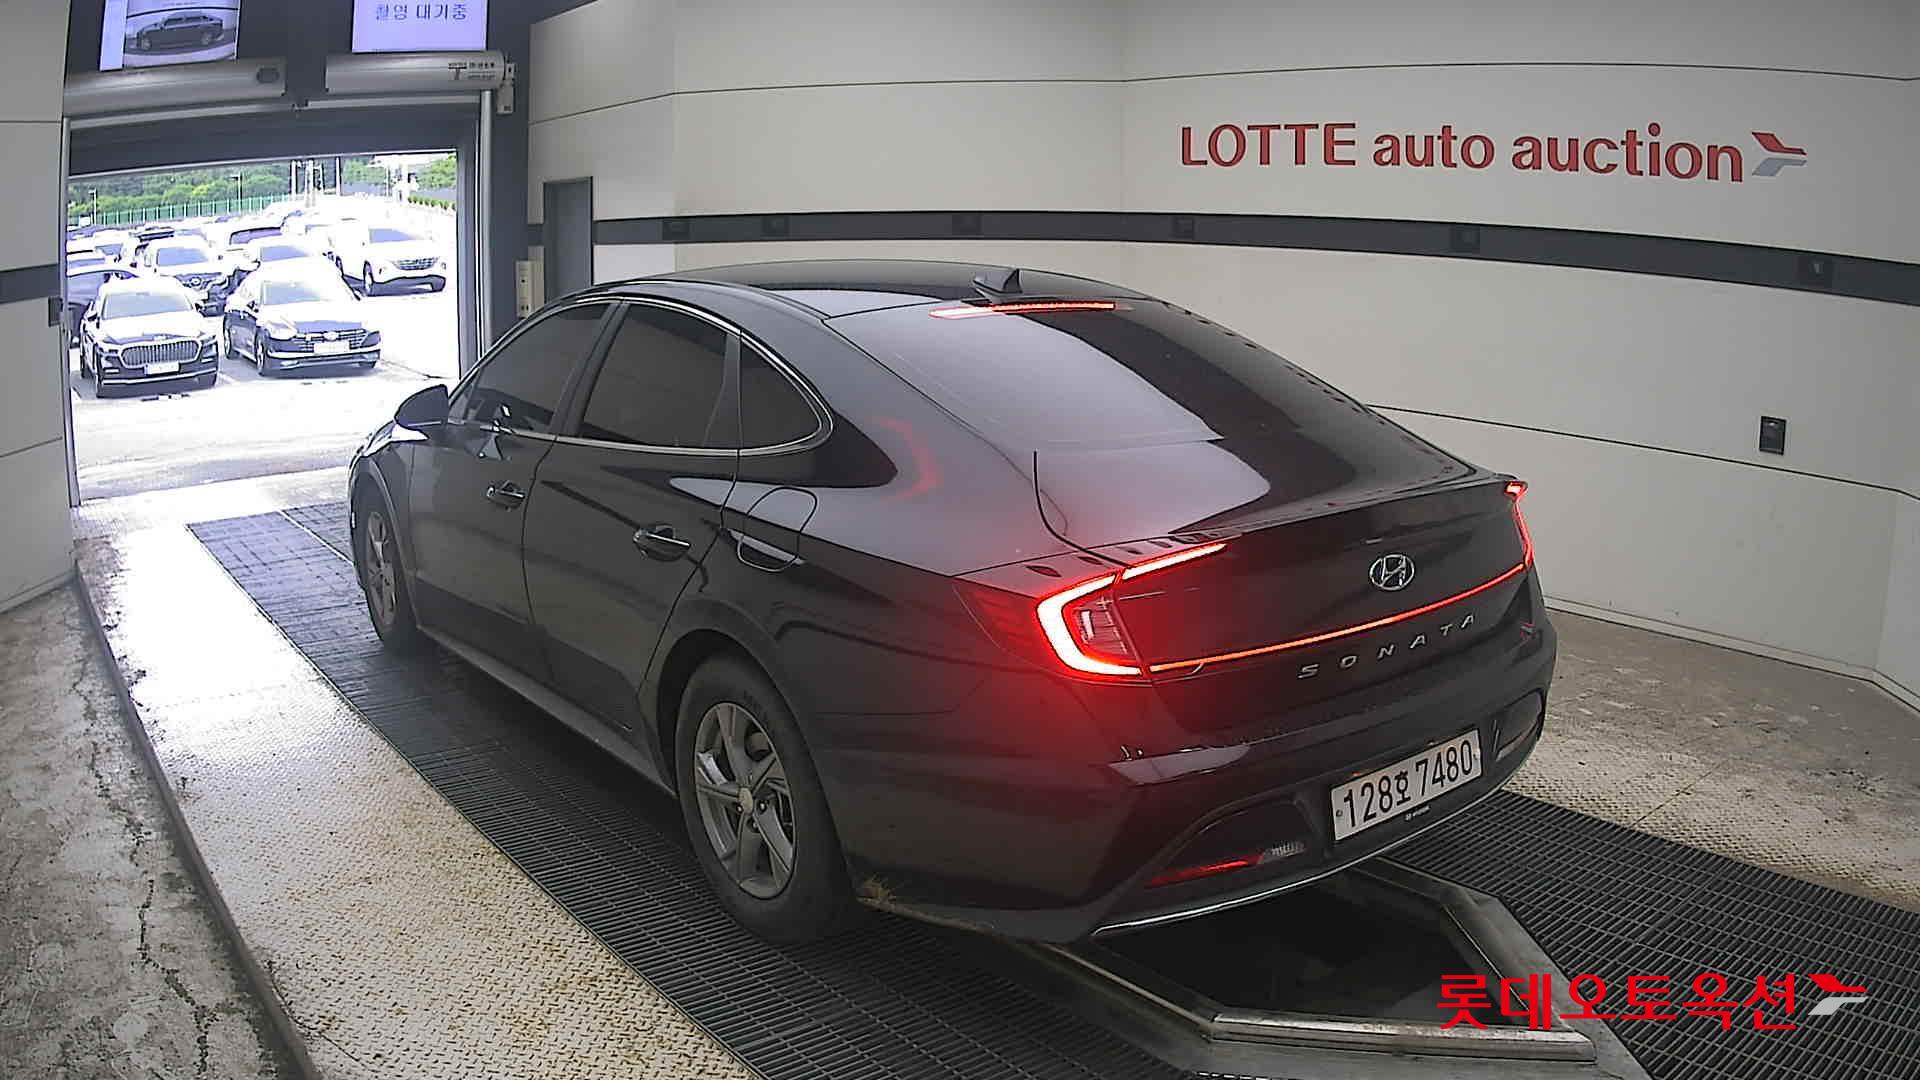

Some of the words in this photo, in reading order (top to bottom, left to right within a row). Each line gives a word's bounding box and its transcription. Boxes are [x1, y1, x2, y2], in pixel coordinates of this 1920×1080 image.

[416, 3, 467, 21] 대기중
[1182, 123, 1356, 166] LOTTE
[1374, 124, 1494, 169] auto
[1513, 122, 1743, 182] auction
[1297, 614, 1475, 679] SONATA
[1343, 770, 1411, 828] 128호
[1415, 739, 1473, 797] 7480
